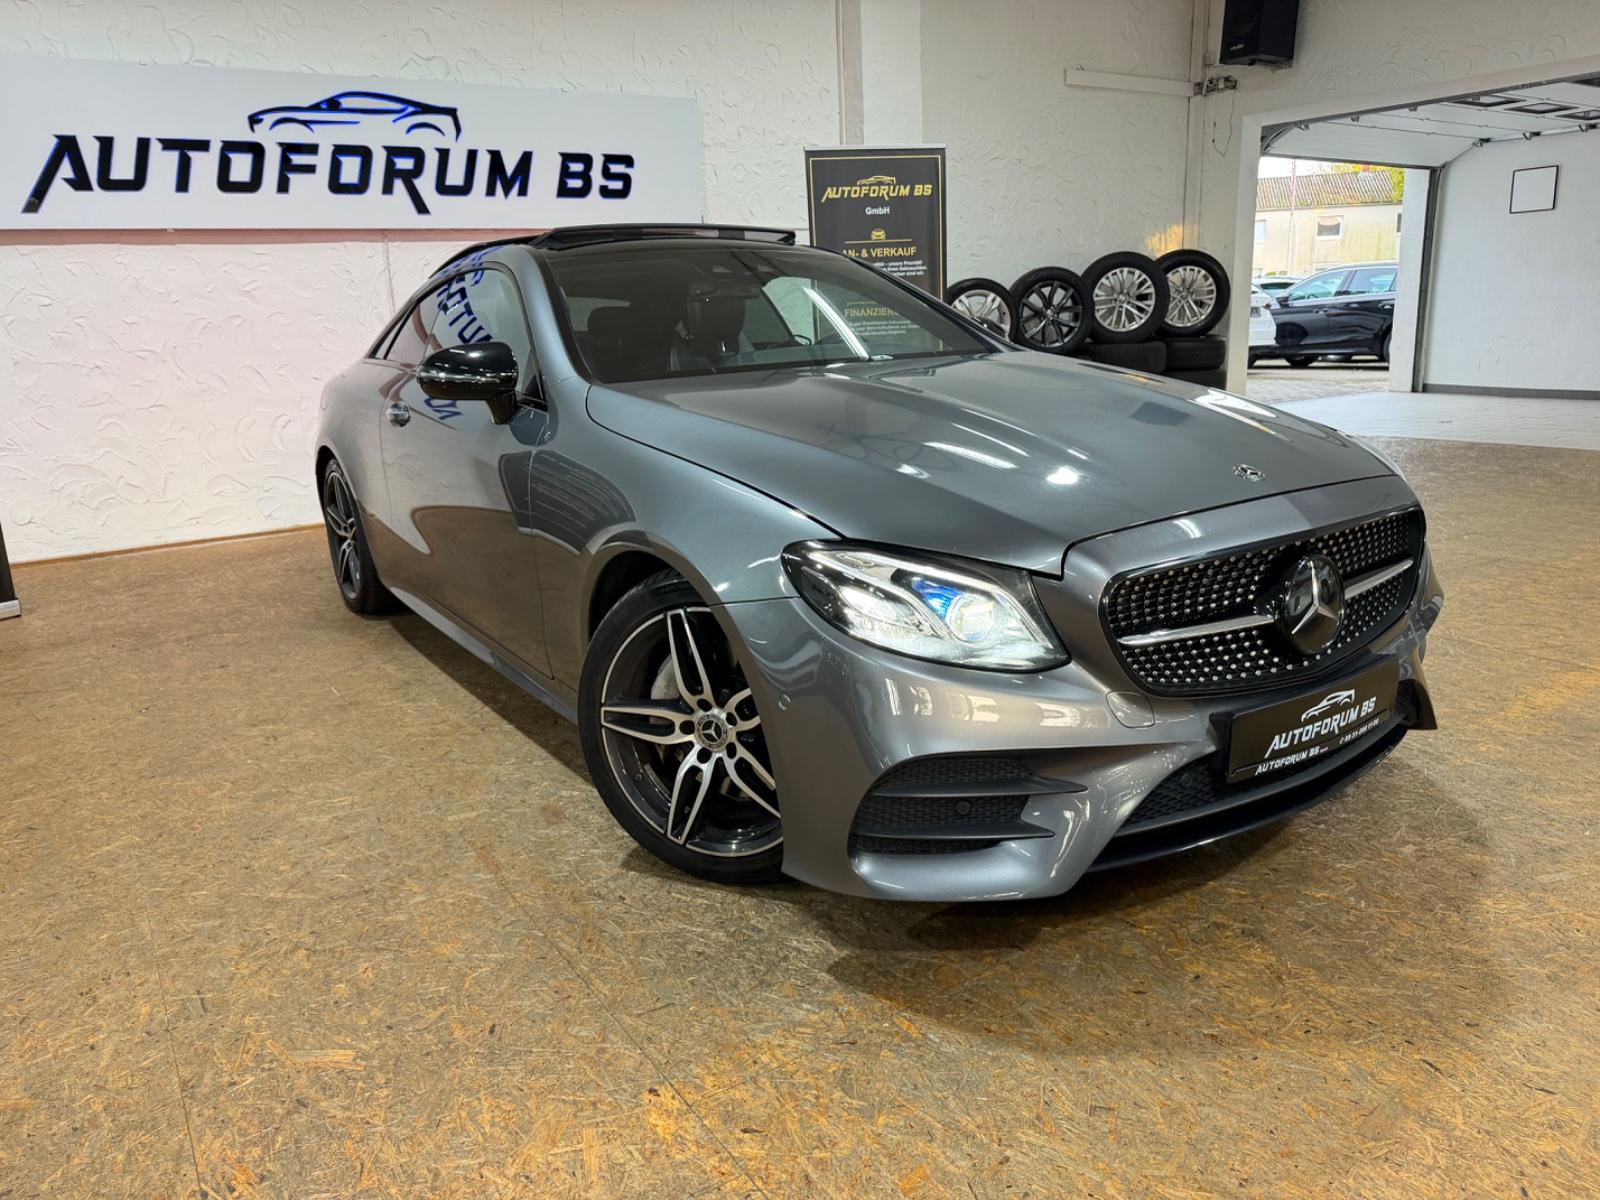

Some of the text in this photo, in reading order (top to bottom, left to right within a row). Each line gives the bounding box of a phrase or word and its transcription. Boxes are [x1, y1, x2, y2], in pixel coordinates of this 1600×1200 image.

[21, 134, 635, 215] AUTOFORUM BS
[821, 184, 932, 203] AUTOFORUM BS
[865, 206, 890, 215] GmbH
[861, 248, 869, 258] &
[870, 247, 917, 257] VERKAUF
[844, 307, 897, 317] FINANZIER
[1264, 705, 1359, 759] AUTOFORUM
[1360, 696, 1377, 717] BS
[1254, 745, 1321, 775] AUTOFORUM BS
